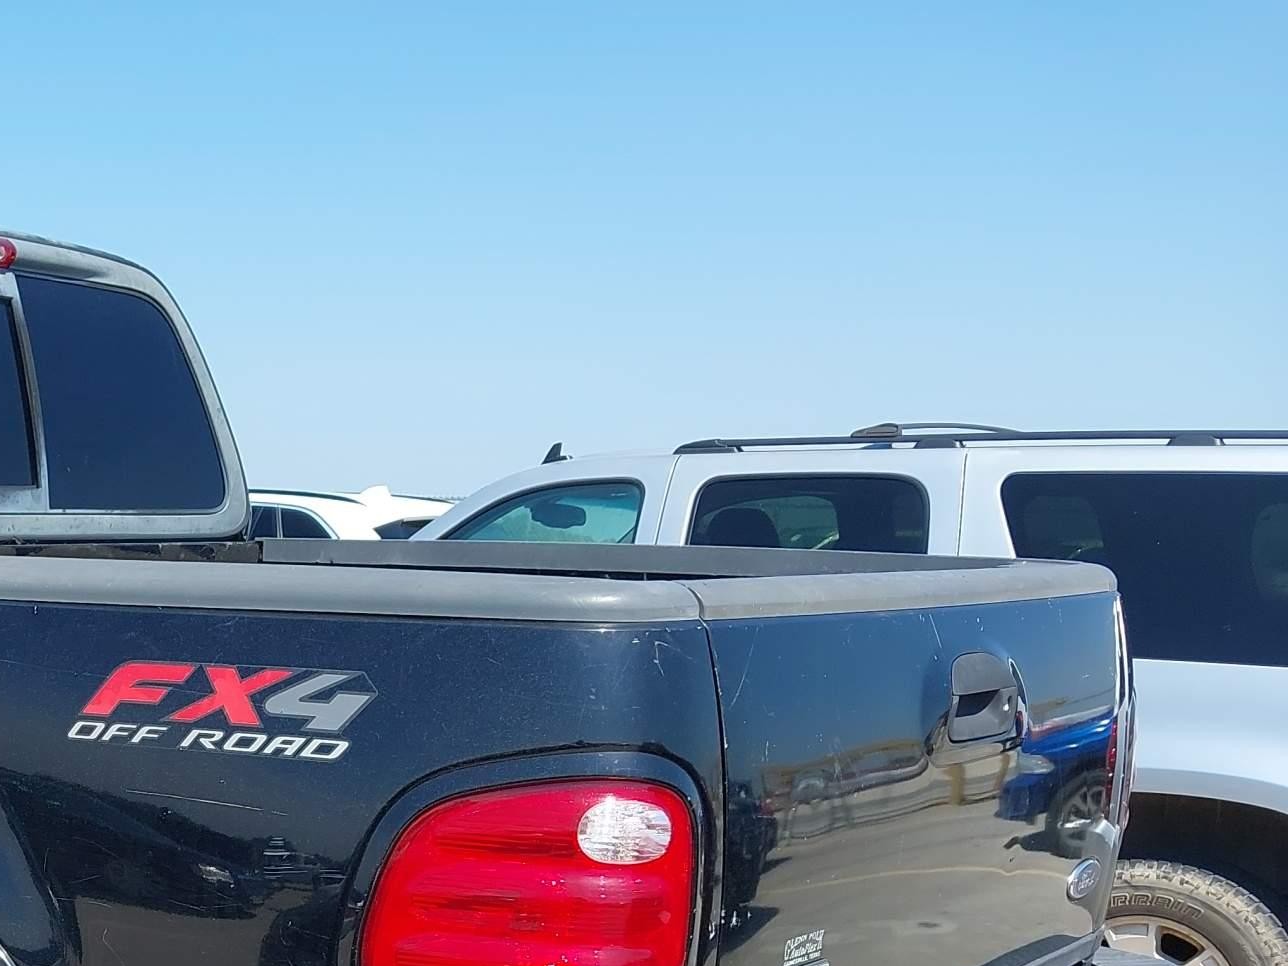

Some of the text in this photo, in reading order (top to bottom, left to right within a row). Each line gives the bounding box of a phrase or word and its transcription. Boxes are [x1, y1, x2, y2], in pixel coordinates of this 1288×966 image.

[79, 660, 379, 734] FX4
[67, 721, 351, 761] OFF ROAD
[1110, 892, 1205, 920] RRAIN
